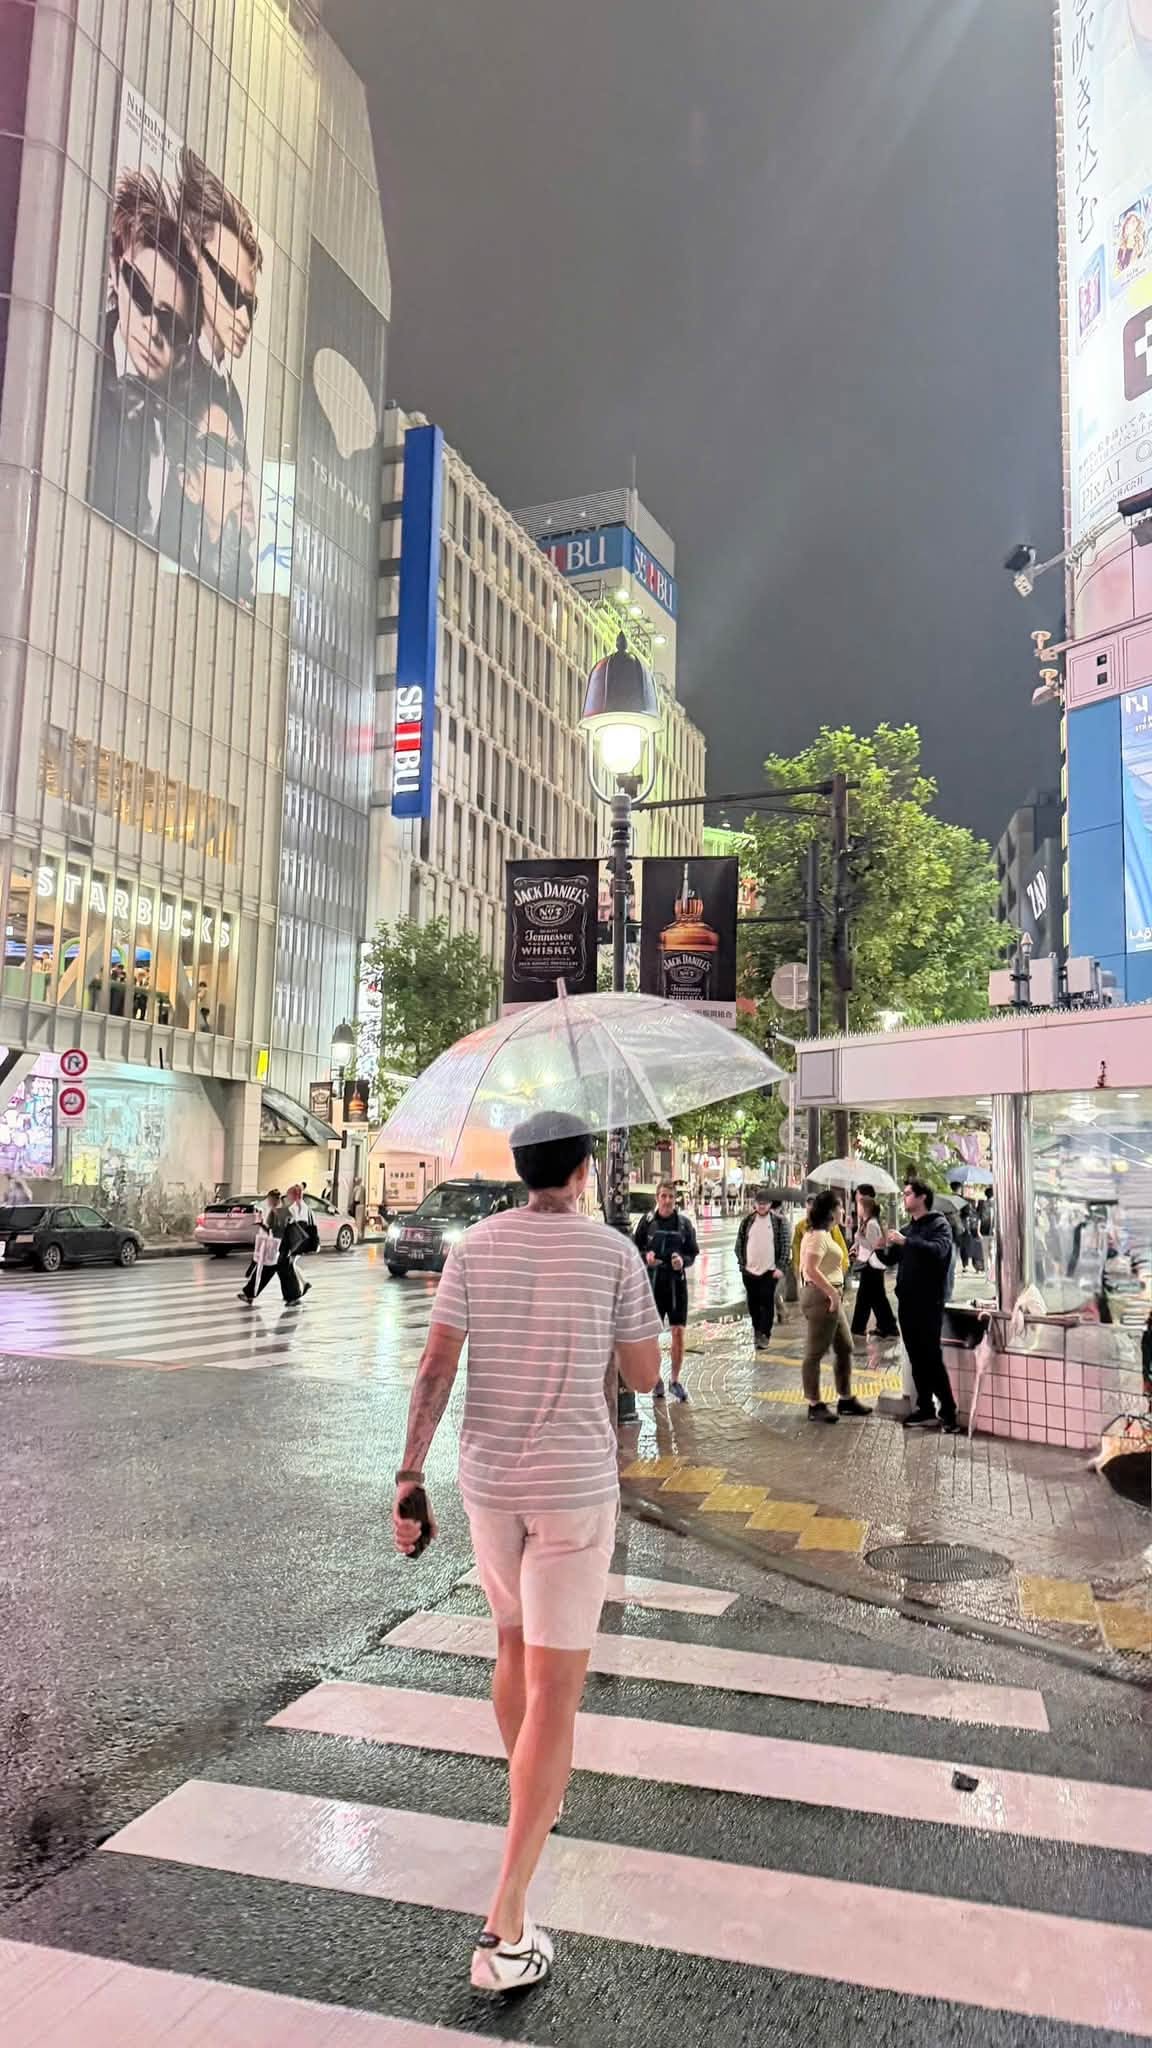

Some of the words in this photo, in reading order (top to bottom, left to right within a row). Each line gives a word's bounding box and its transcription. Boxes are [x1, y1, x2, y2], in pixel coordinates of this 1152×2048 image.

[311, 455, 372, 524] TSUTAYA
[548, 535, 606, 571] IBU
[633, 544, 673, 612] SEIBU
[394, 685, 422, 796] SEIBU
[37, 866, 231, 948] STARBUCKS
[513, 885, 543, 907] JACK
[543, 881, 590, 906] DANIEL'S
[521, 946, 577, 955] WHISKEY
[524, 929, 574, 942] Tennessee
[663, 957, 682, 974] JACK
[682, 954, 712, 975] DANIEL'S
